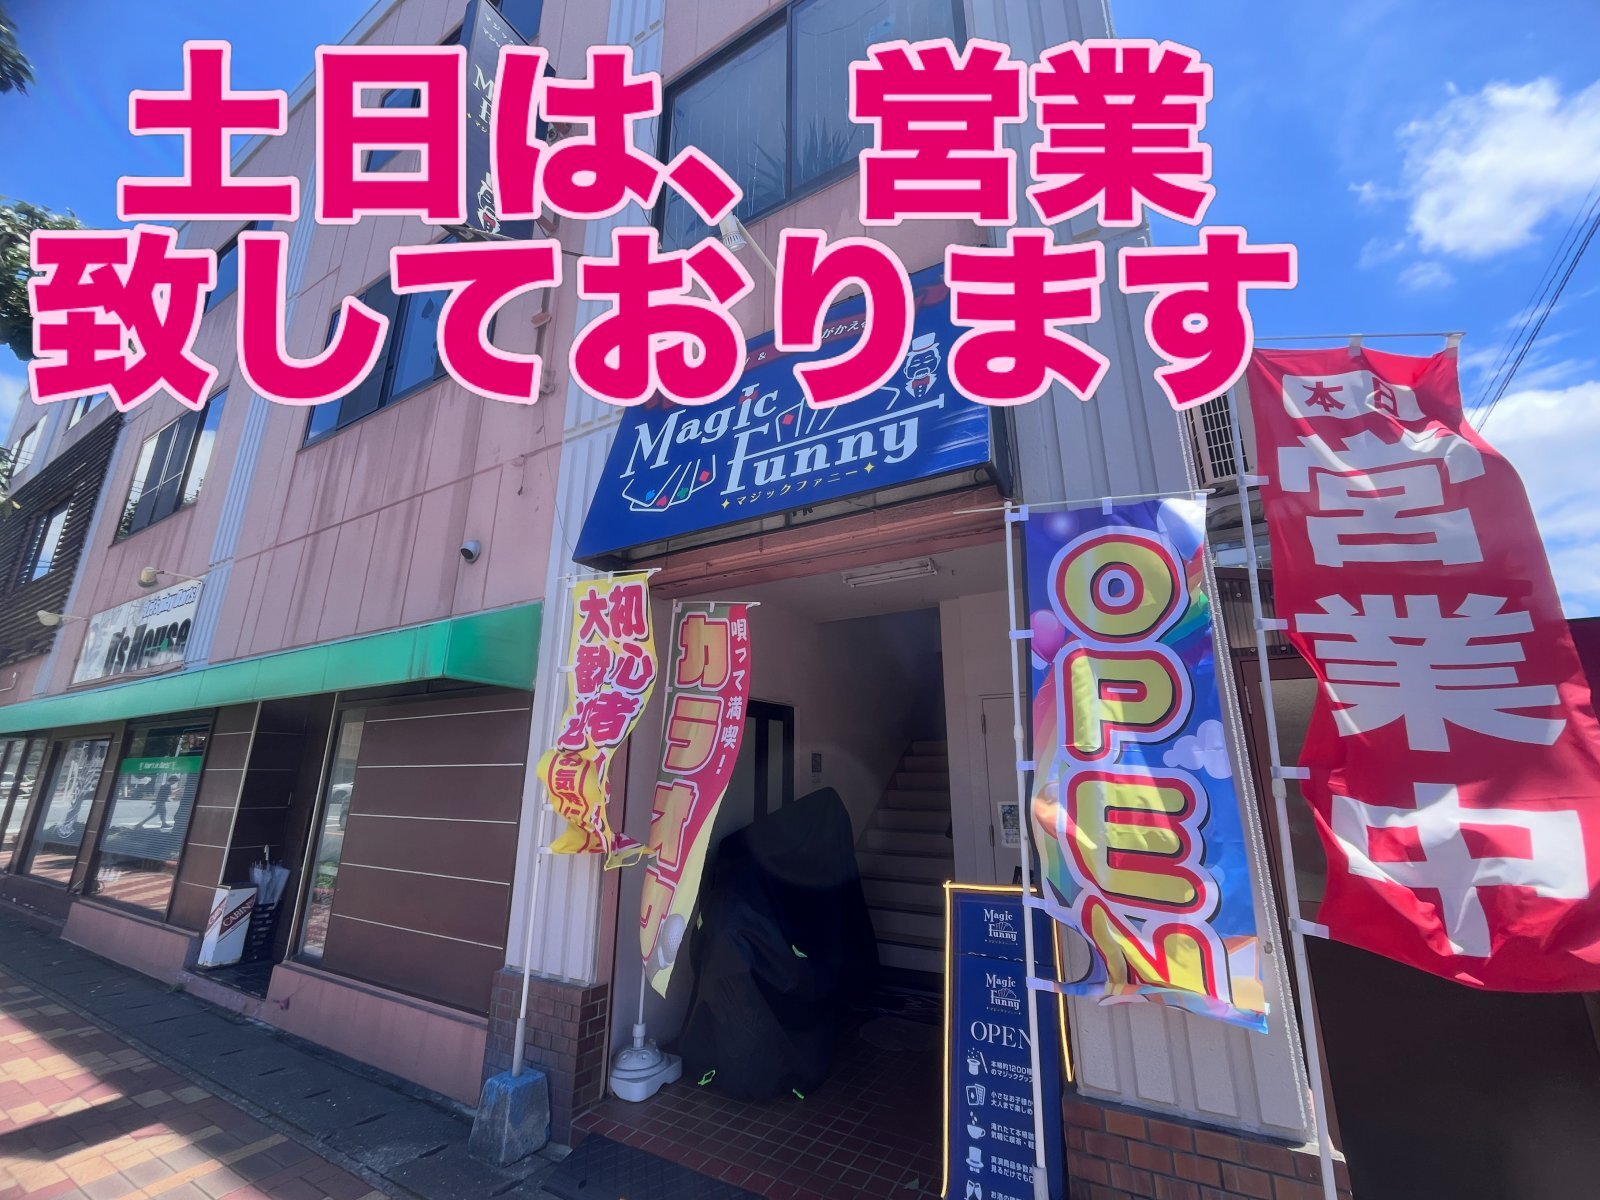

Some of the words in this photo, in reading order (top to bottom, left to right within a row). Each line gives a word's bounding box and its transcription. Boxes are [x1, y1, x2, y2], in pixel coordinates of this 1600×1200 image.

[1302, 377, 1400, 418] 本日
[620, 383, 778, 478] Magic
[720, 398, 940, 496] Funny
[736, 470, 858, 505] マジックファニー
[1277, 428, 1590, 958] 営業中
[1048, 527, 1227, 1003] OPEN
[641, 613, 731, 961] カラオケ
[984, 909, 1013, 922] Magic
[988, 923, 1017, 941] Funny
[986, 973, 1016, 988] Magic
[990, 990, 1020, 1010] Funny
